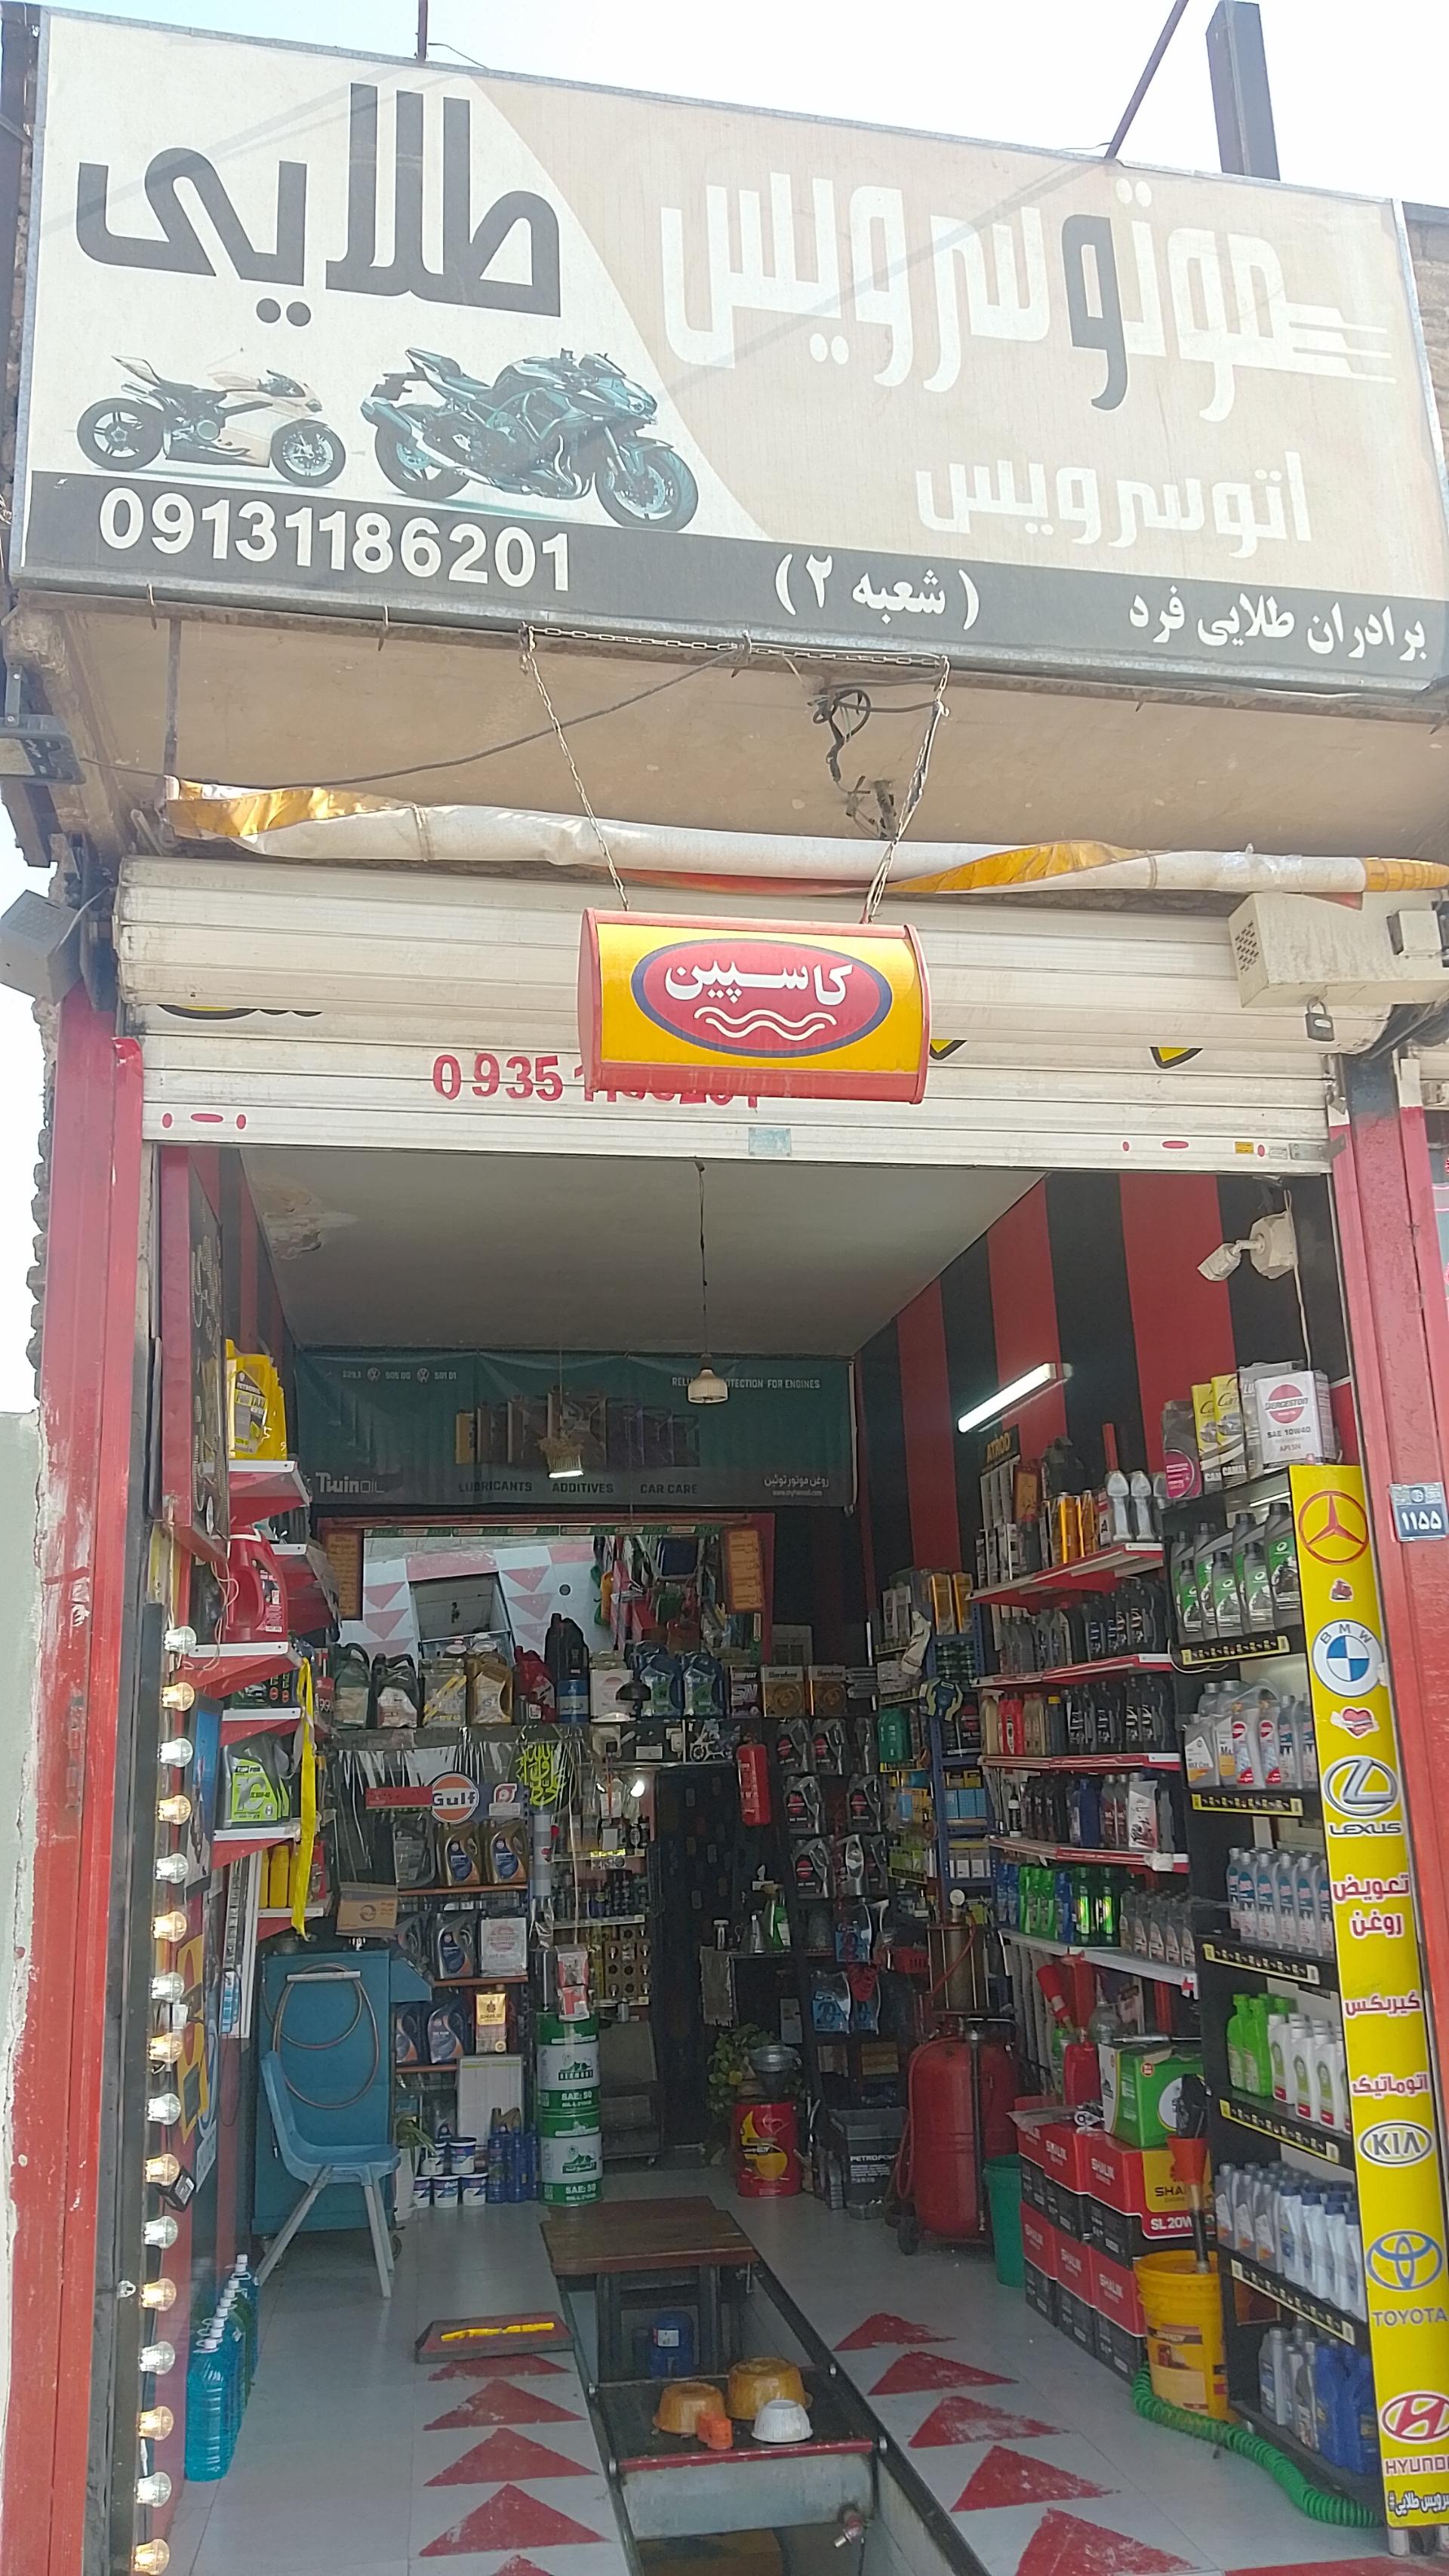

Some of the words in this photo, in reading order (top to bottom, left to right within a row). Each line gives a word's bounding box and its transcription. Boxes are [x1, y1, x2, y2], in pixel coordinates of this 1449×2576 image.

[75, 82, 561, 328] طلایی
[916, 451, 1312, 559] اتوسرویس
[99, 488, 570, 592] 09131186201
[1128, 584, 1186, 644] فرد
[1196, 592, 1295, 649] طلایی
[1306, 602, 1426, 663] برادران
[664, 959, 853, 1007] کاسپین
[768, 1378, 783, 1388] FOR
[785, 1379, 820, 1389] ENGINES
[459, 1481, 532, 1493] LUBRICANTS
[552, 1482, 614, 1493] ADDITIVES
[640, 1483, 664, 1494] CAR
[668, 1483, 698, 1494] CARE
[1401, 1510, 1442, 1531] ۱۱۵۵
[1320, 1623, 1373, 1645] BMW
[432, 1791, 476, 1806] Gulf
[1330, 1824, 1402, 1836] LEXUS
[1333, 1874, 1411, 1901] تعویض
[1352, 1911, 1402, 1937] روغن
[1352, 2075, 1429, 2097] اتوماتیک
[1371, 2131, 1422, 2156] KIA
[1150, 2217, 1167, 2230] SL
[1372, 2307, 1449, 2327] TOYOTA
